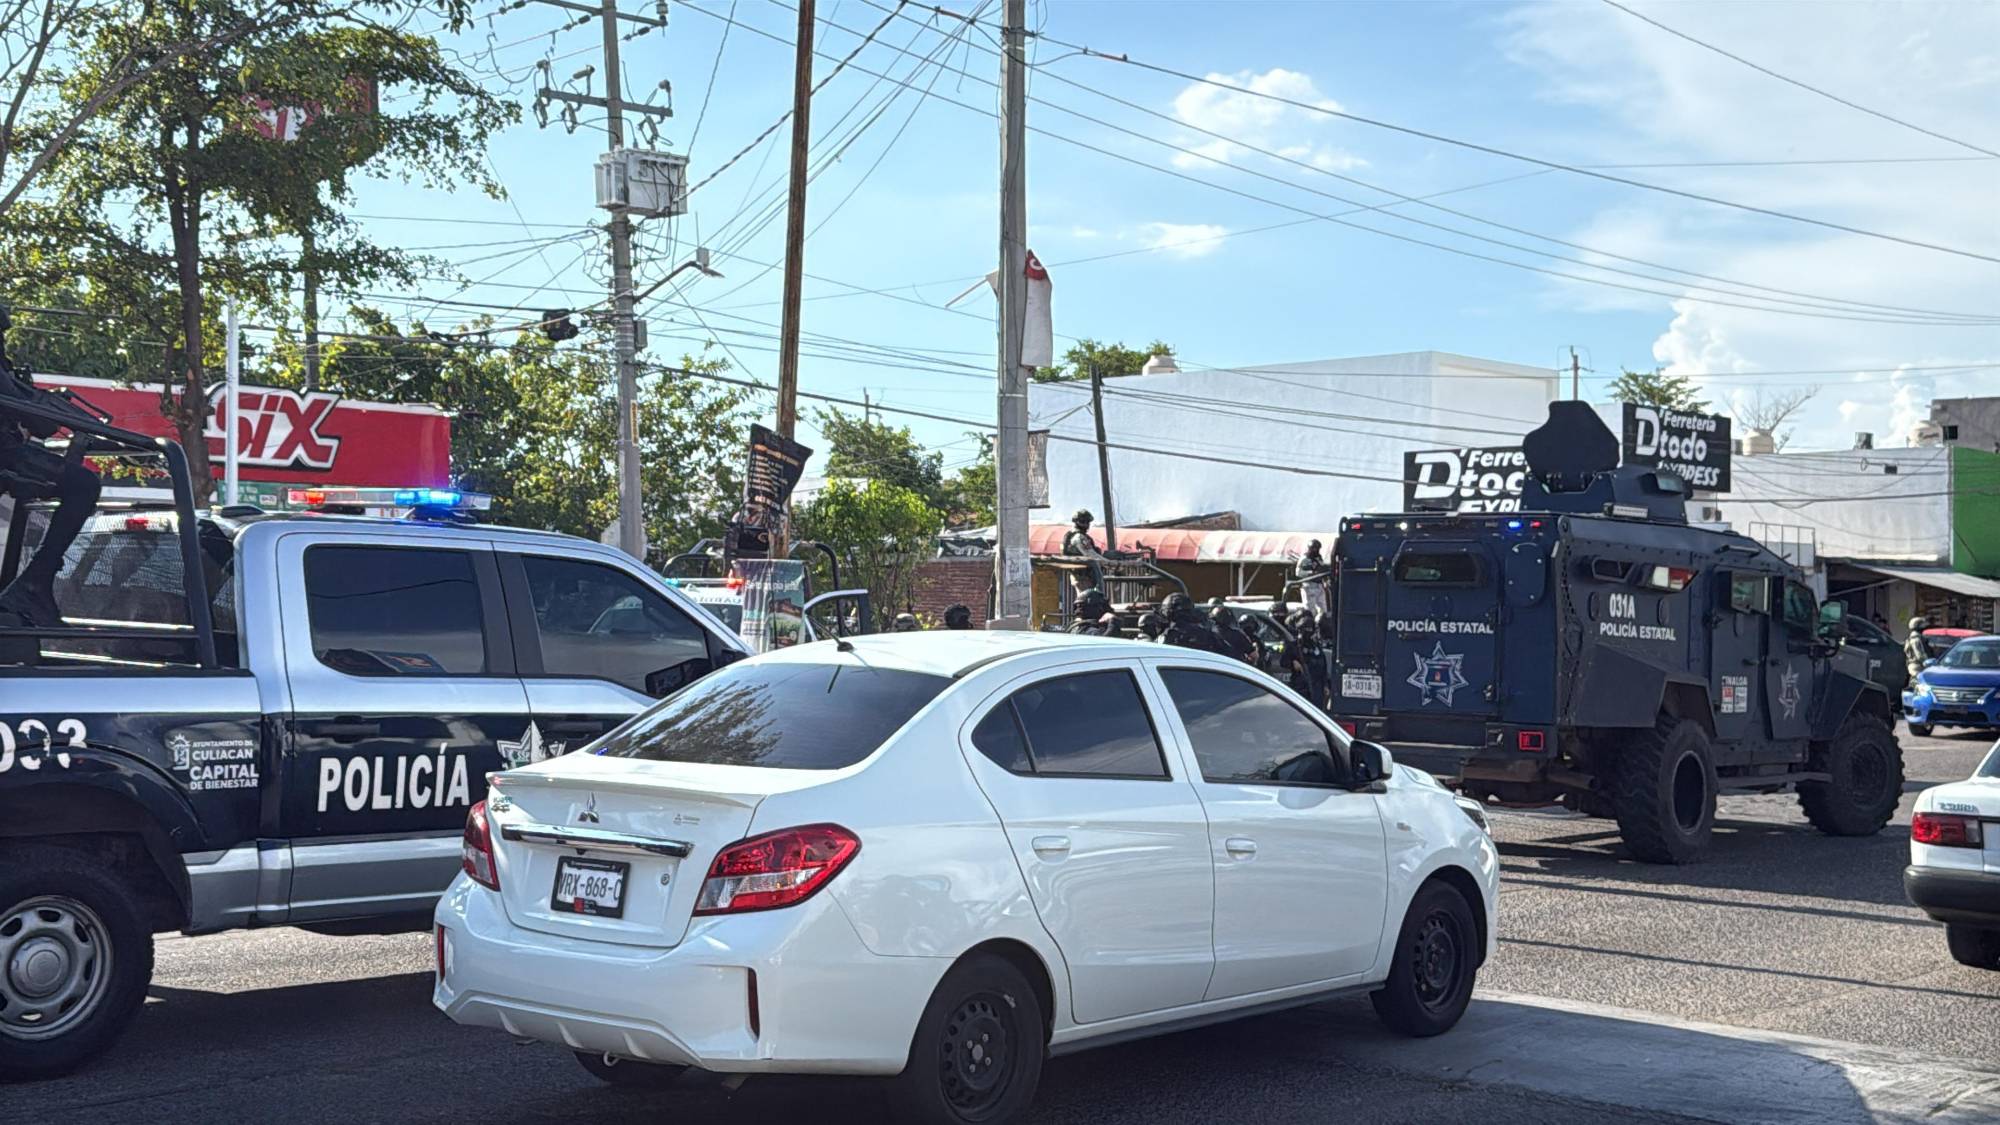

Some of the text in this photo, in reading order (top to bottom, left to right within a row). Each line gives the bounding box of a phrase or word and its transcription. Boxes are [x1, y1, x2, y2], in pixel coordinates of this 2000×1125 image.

[1467, 451, 1526, 467] Ferre
[1609, 593, 1636, 619] 031A
[1388, 619, 1494, 634] POLICÍA ESTATAL
[1600, 622, 1676, 640] POLICÍA ESTATAL
[190, 763, 260, 780] CAPITAL
[317, 742, 470, 812] POLICÍA
[190, 779, 258, 790] DE BIENESTAR
